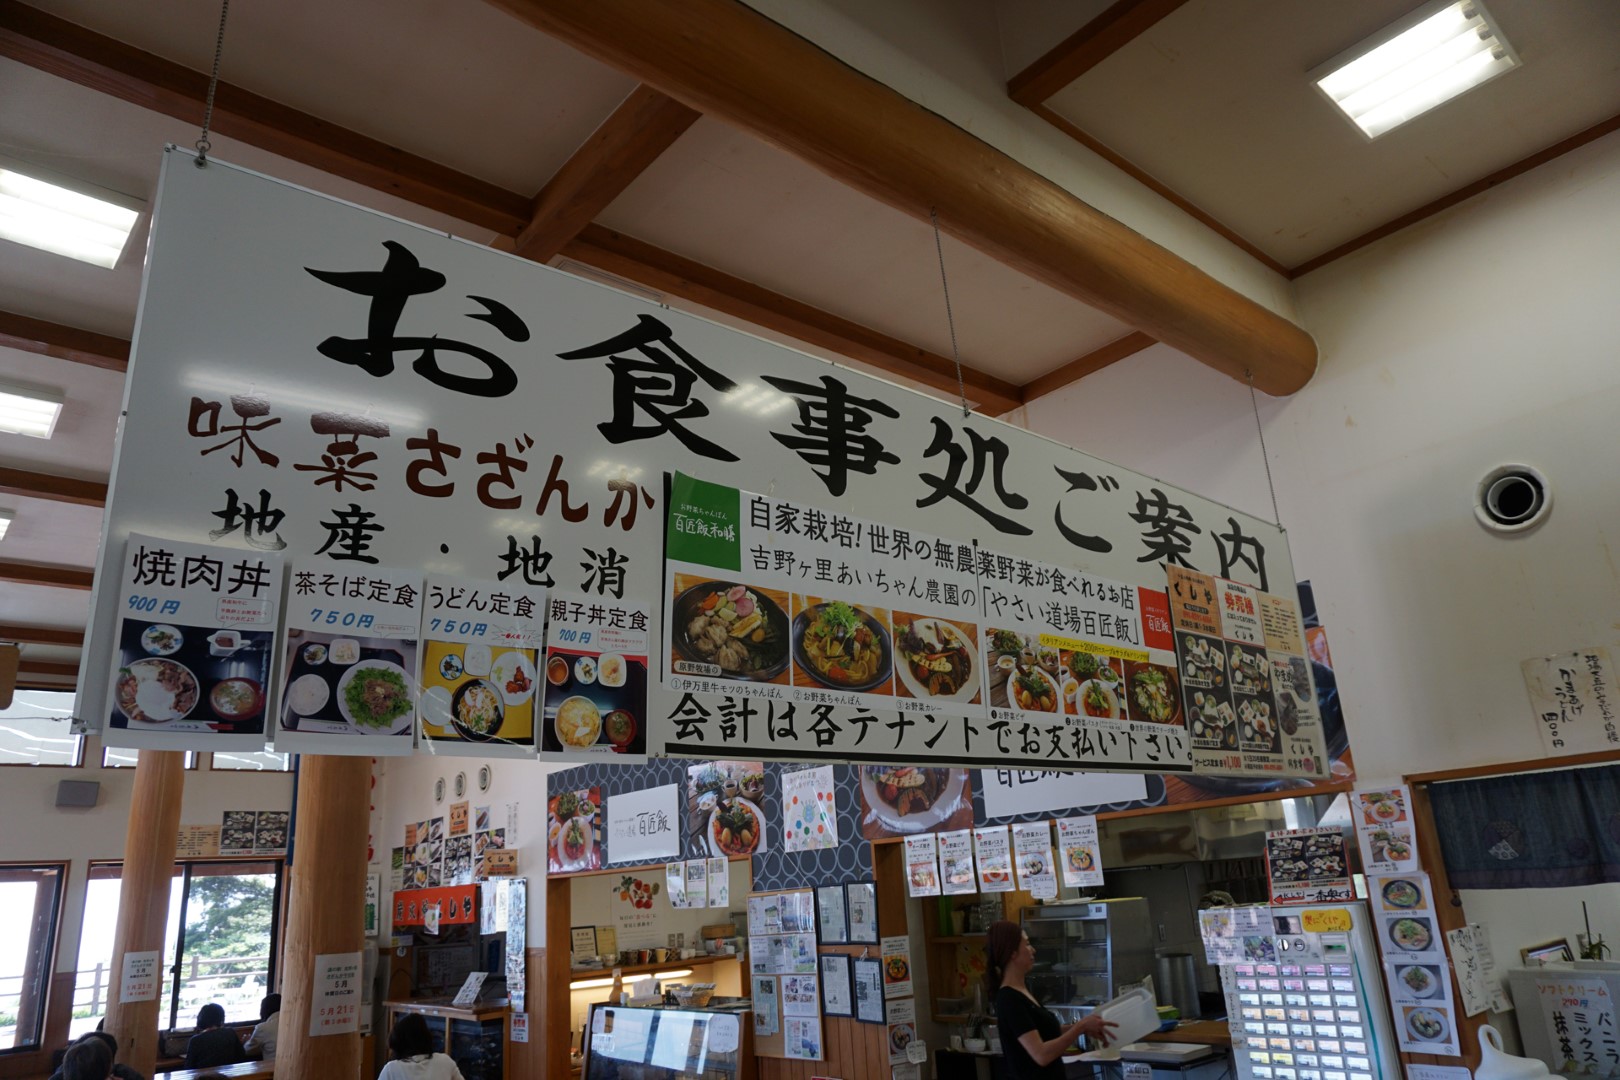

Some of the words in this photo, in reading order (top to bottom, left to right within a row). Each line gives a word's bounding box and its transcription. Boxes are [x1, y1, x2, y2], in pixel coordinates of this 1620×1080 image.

[304, 240, 1268, 592] お食事処ご案内
[187, 392, 655, 531] 味菜さざんか
[208, 488, 630, 600] 地産・地消
[132, 545, 271, 598] 焼肉丼
[294, 571, 418, 609] 茶そば定食
[429, 584, 537, 619] うどん定食
[1174, 580, 1213, 605] くしや
[1224, 591, 1255, 616] 券売機
[310, 608, 375, 629] 750円
[430, 617, 488, 637] 750円
[551, 598, 649, 632] 親子丼定食
[1145, 614, 1172, 634] 百匠飯
[678, 662, 719, 675] 原野牧場の
[637, 809, 672, 837] 百匠飯
[334, 980, 348, 989] 5月
[1537, 984, 1608, 997] ソフトクリーム
[1552, 1010, 1575, 1062] 抹茶
[1573, 1012, 1599, 1063] ミックス
[1598, 1011, 1620, 1065] バニラ
